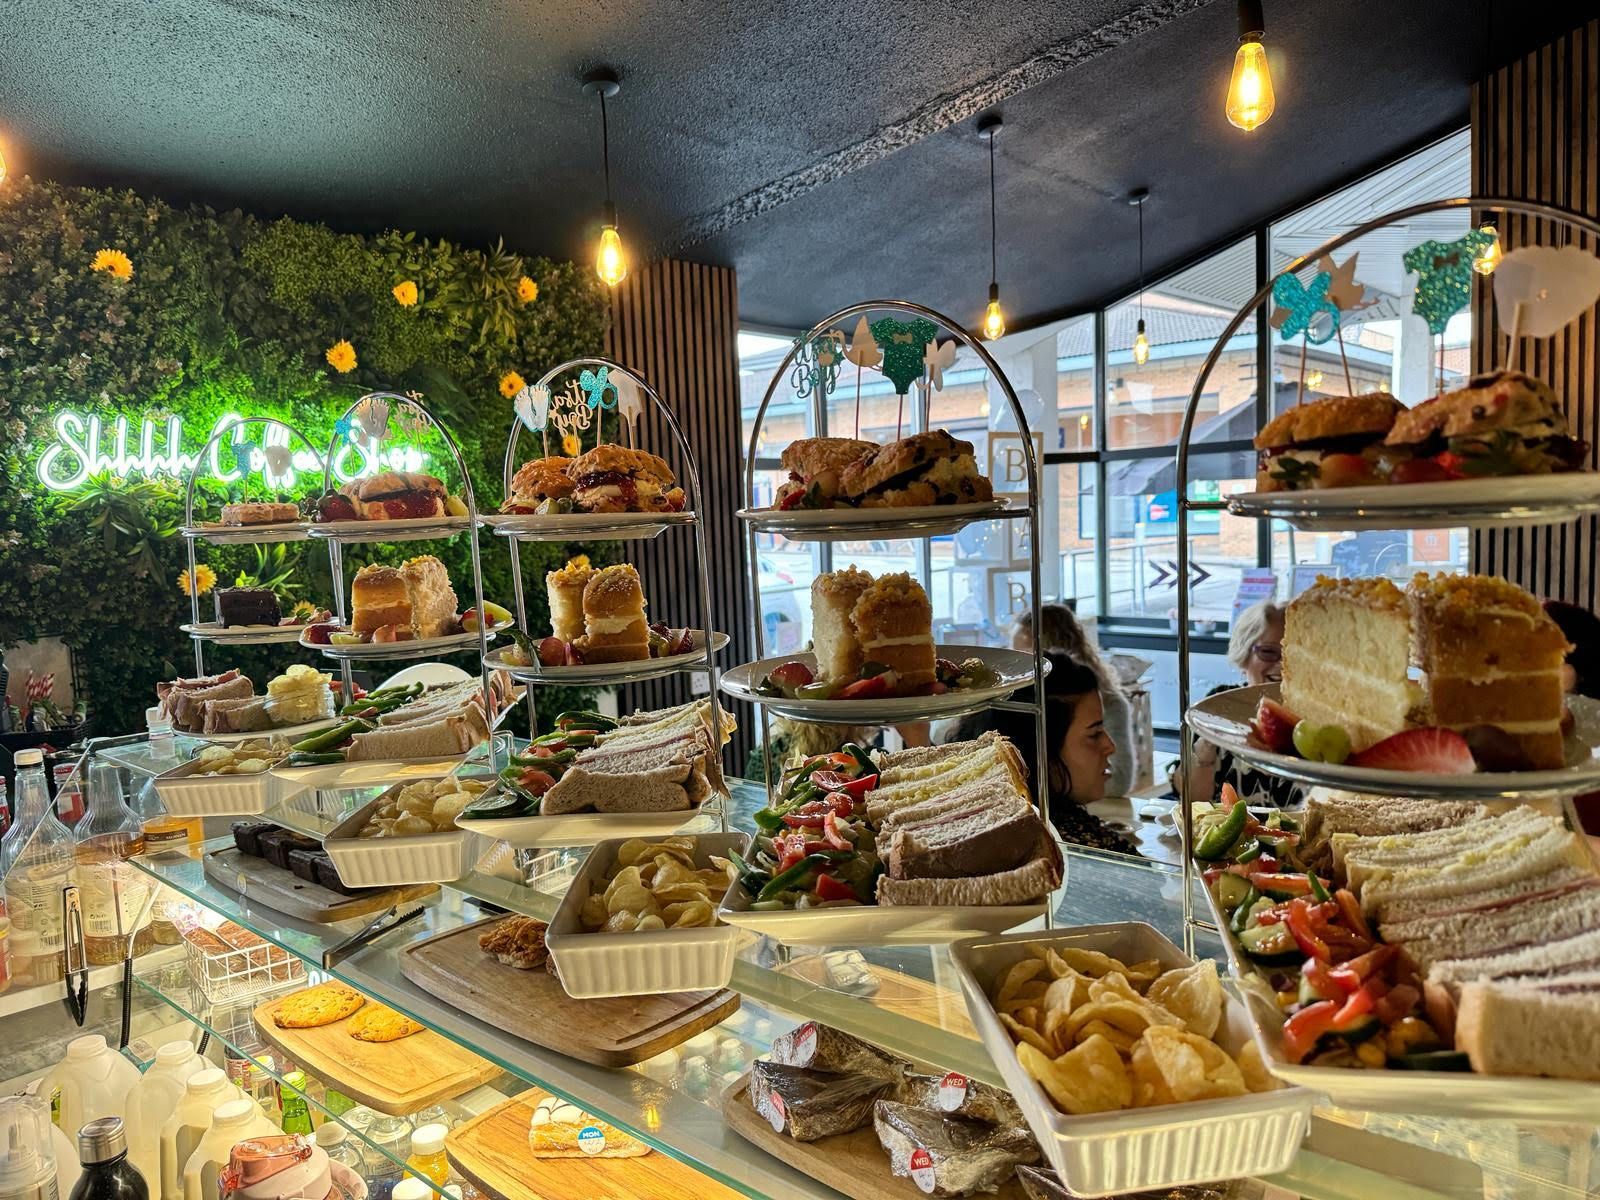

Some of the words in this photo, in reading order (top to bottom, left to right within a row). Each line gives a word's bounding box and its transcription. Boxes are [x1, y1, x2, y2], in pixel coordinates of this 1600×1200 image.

[1005, 447, 1027, 483] B
[946, 1078, 963, 1086] WED
[582, 1130, 600, 1139] MON
[913, 1156, 930, 1167] WED
